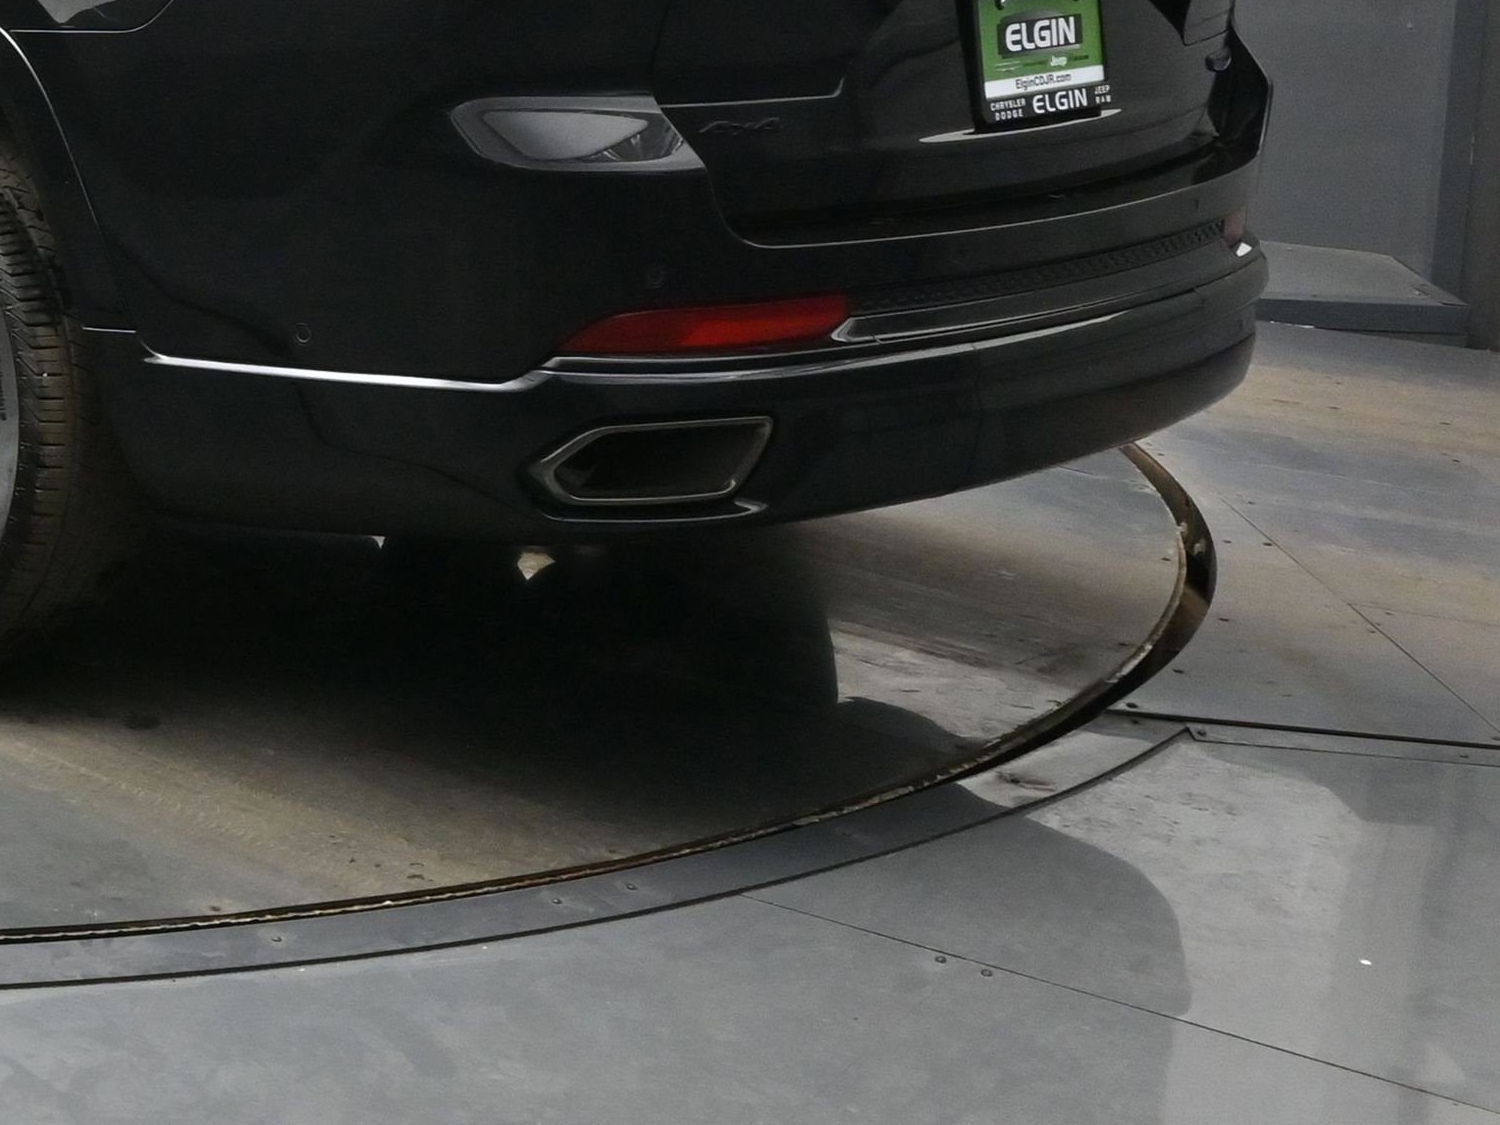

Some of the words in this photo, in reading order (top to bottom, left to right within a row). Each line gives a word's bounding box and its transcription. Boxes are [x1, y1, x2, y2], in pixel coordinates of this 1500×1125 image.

[1005, 16, 1076, 52] ELGIN
[1015, 73, 1072, 91] ElginCDJR.com
[1094, 85, 1110, 95] JEEP
[990, 98, 1026, 112] CHRYSLER
[1032, 88, 1088, 114] ELGIN
[1095, 95, 1112, 104] RAM
[995, 109, 1023, 121] DODGE
